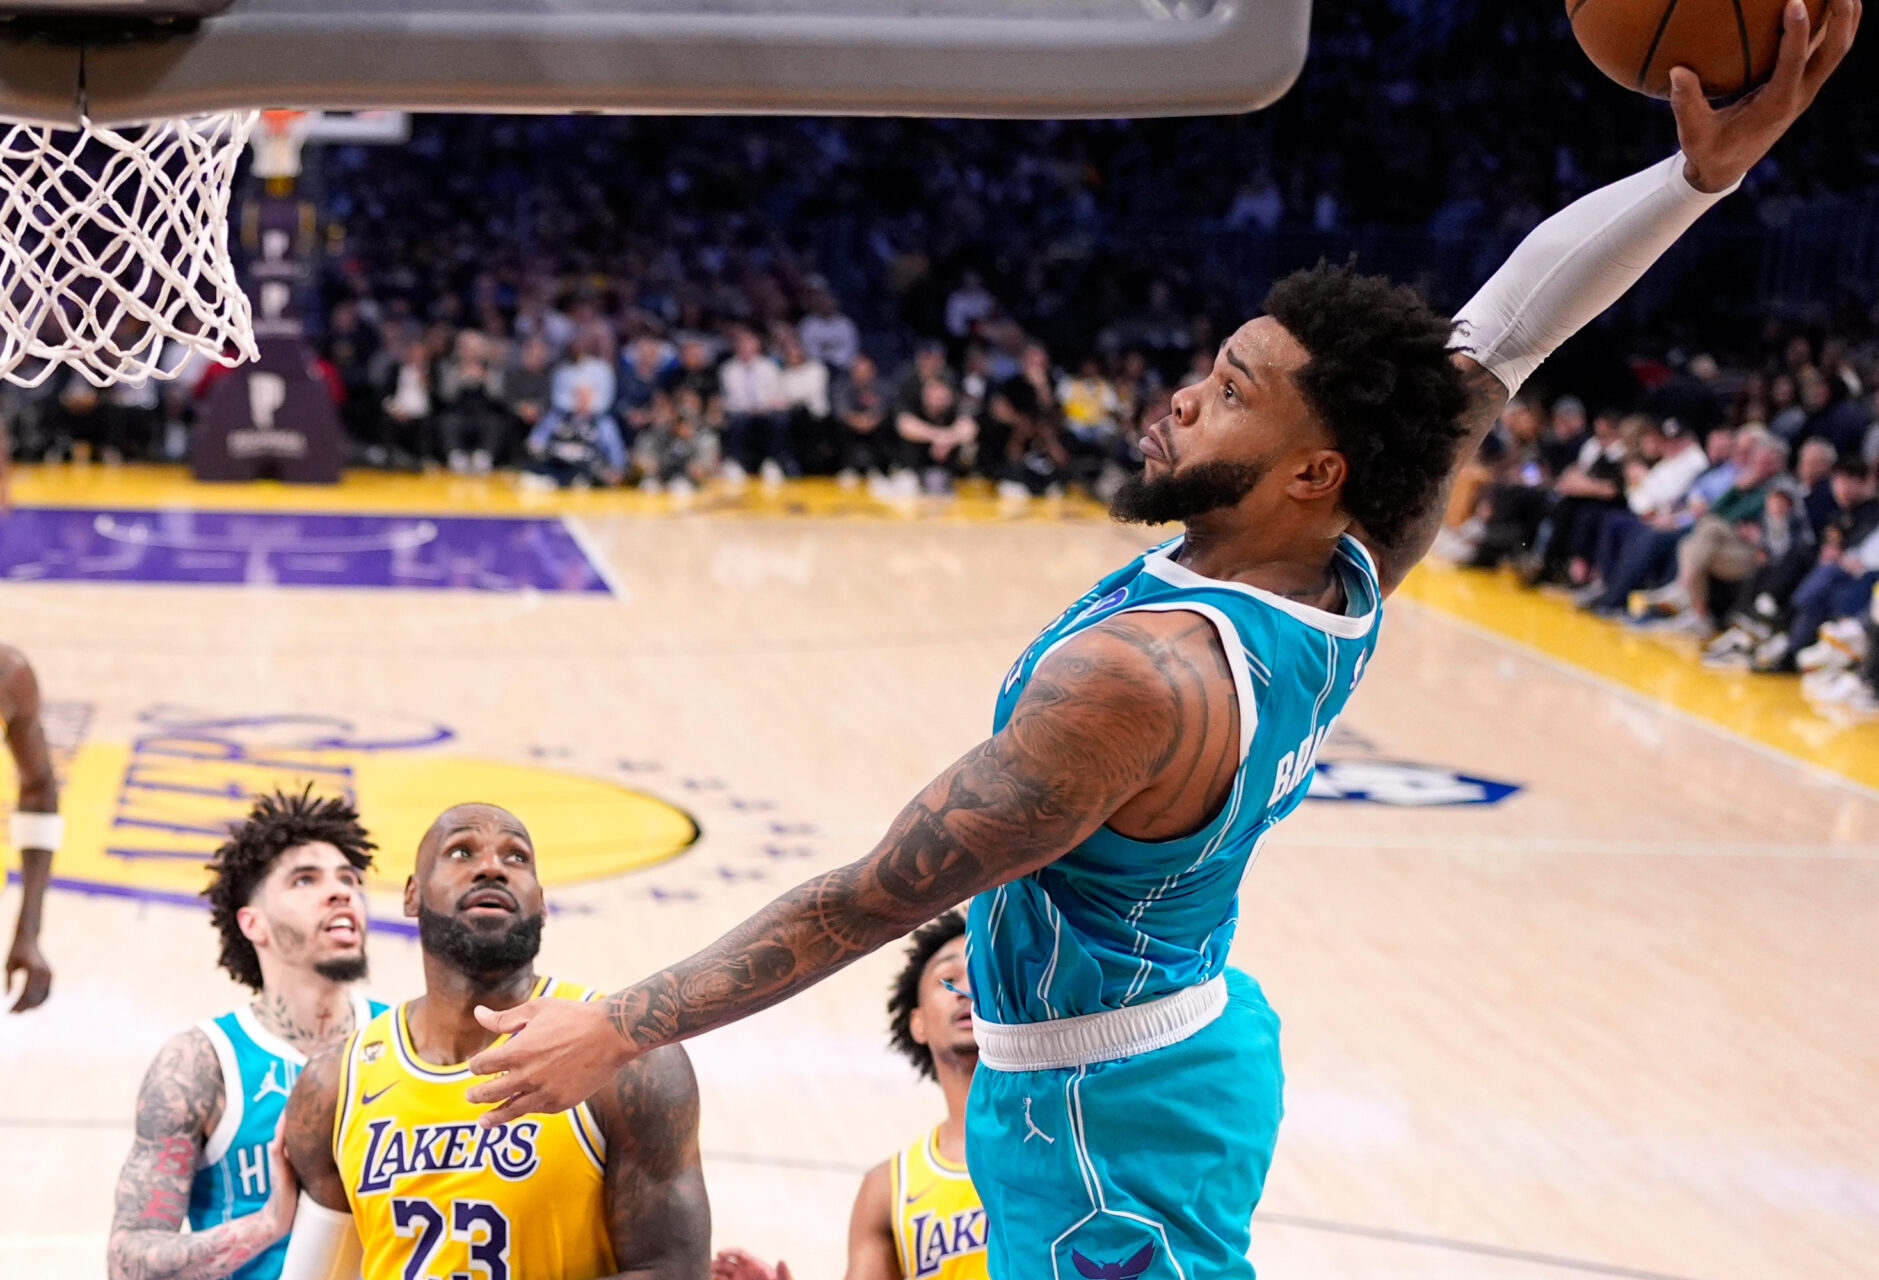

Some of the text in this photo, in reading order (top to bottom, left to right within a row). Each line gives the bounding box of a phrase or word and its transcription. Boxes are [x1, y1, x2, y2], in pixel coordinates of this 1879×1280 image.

[1267, 713, 1340, 808] BRI
[237, 1142, 276, 1196] H
[357, 1116, 541, 1197] LAKERS
